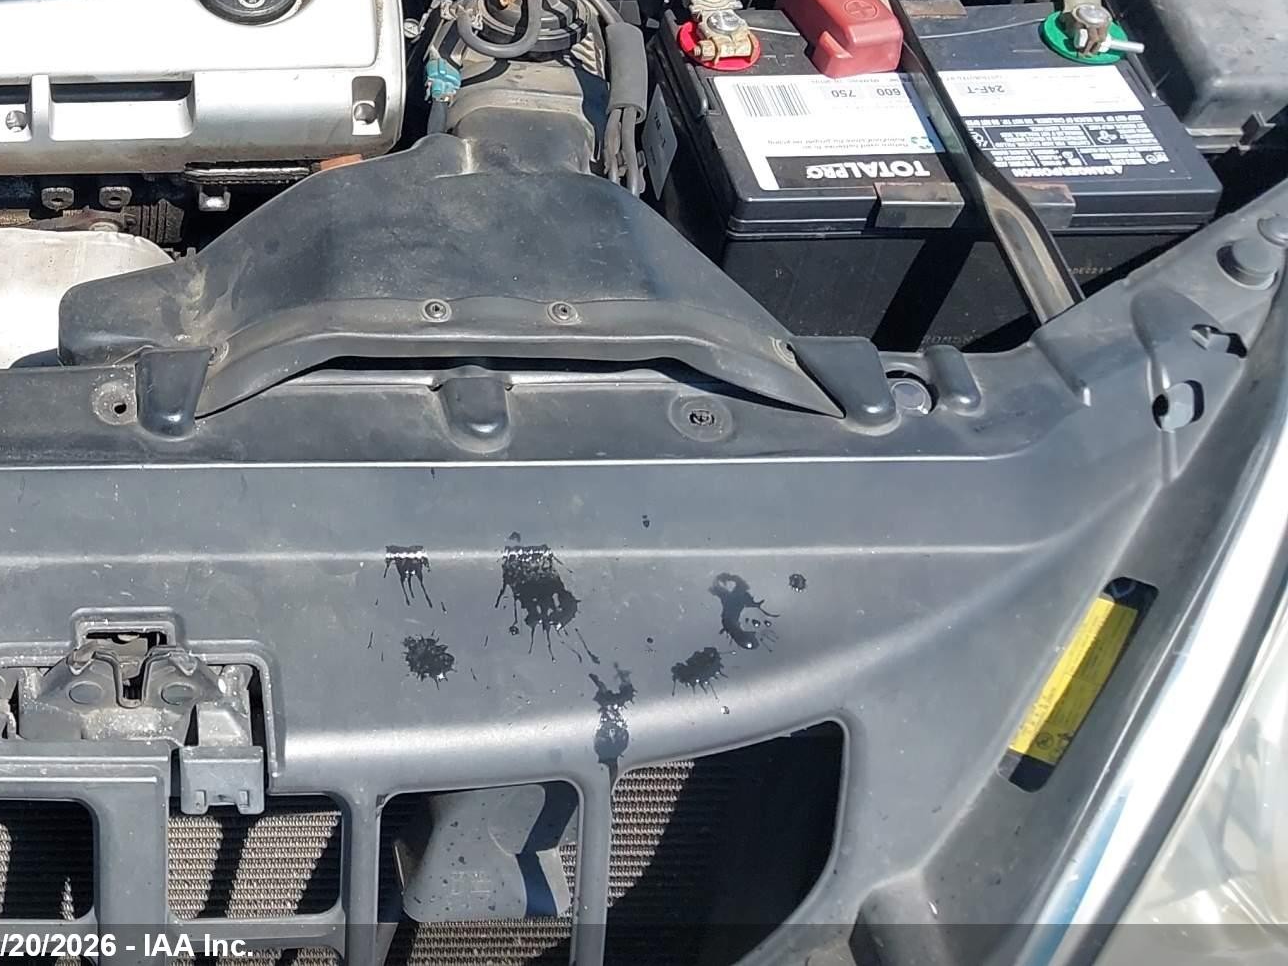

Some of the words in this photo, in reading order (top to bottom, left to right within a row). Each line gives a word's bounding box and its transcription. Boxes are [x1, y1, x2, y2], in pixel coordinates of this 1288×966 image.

[831, 88, 857, 98] 750
[876, 87, 901, 97] 600
[805, 160, 931, 180] TOTALPRO
